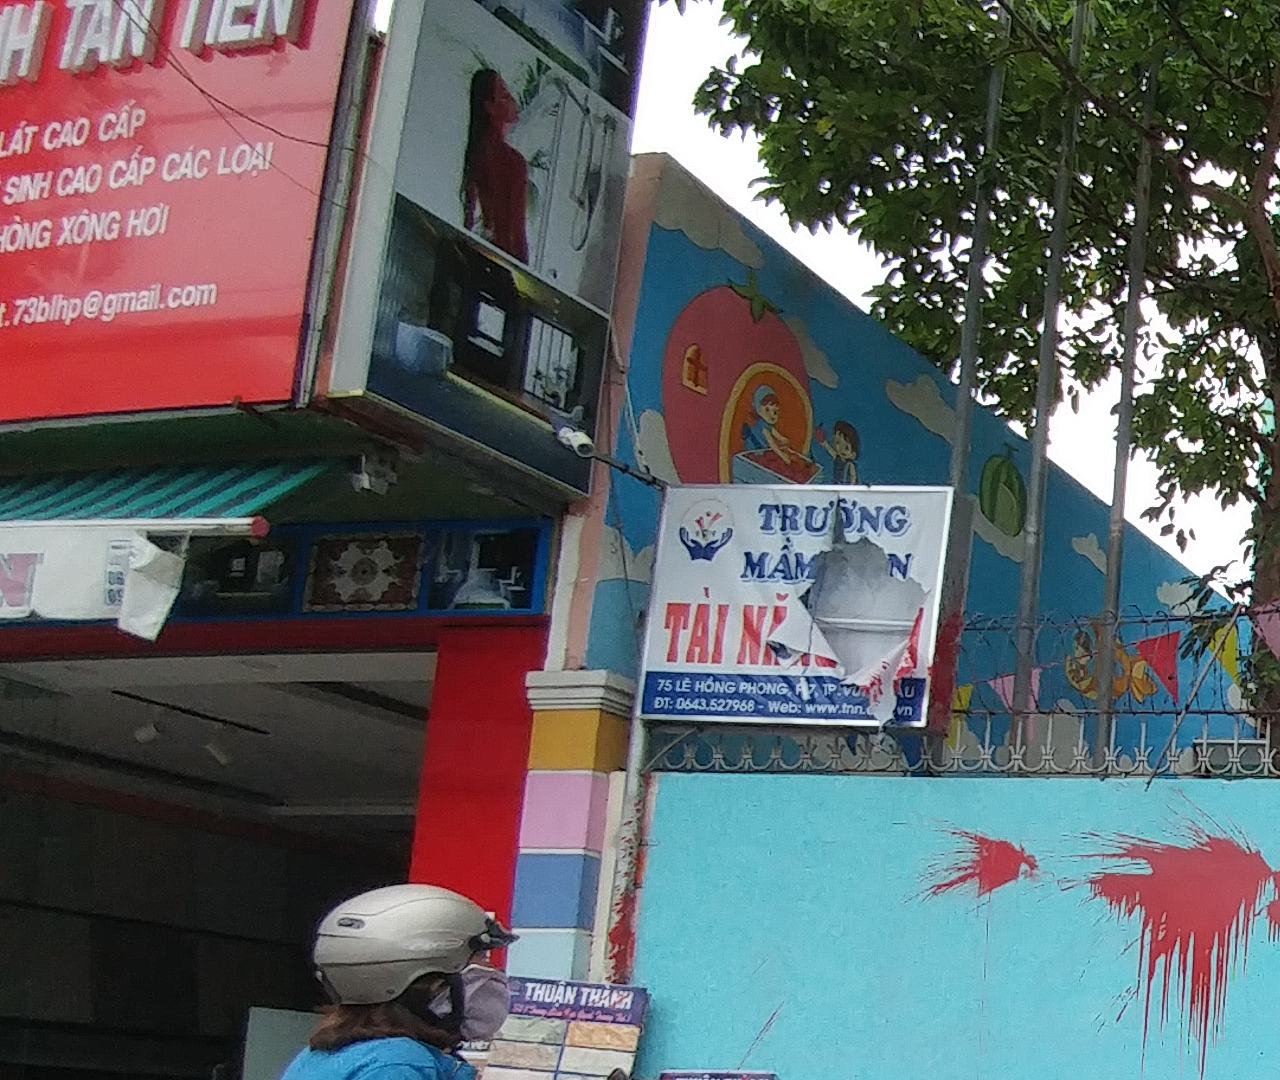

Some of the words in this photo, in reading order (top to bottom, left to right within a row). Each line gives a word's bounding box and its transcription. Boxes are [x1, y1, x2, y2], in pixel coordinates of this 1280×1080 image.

[43, 117, 91, 151] CAO
[97, 99, 146, 141] CẤP
[4, 171, 54, 205] SINH
[57, 163, 102, 196] CAO
[109, 145, 156, 189] CẤP
[162, 146, 211, 182] CÁC
[217, 141, 274, 177] LOẠI
[56, 207, 122, 246] XÔNG
[126, 202, 170, 238] HƠI
[664, 586, 730, 663] TÀI
[654, 698, 675, 711] ĐT:
[768, 702, 801, 715] Web:
[656, 679, 673, 692] 75
[696, 677, 735, 694] HỒNG
[525, 980, 577, 1008] THUẬN
[580, 985, 635, 1010] THÀNH
